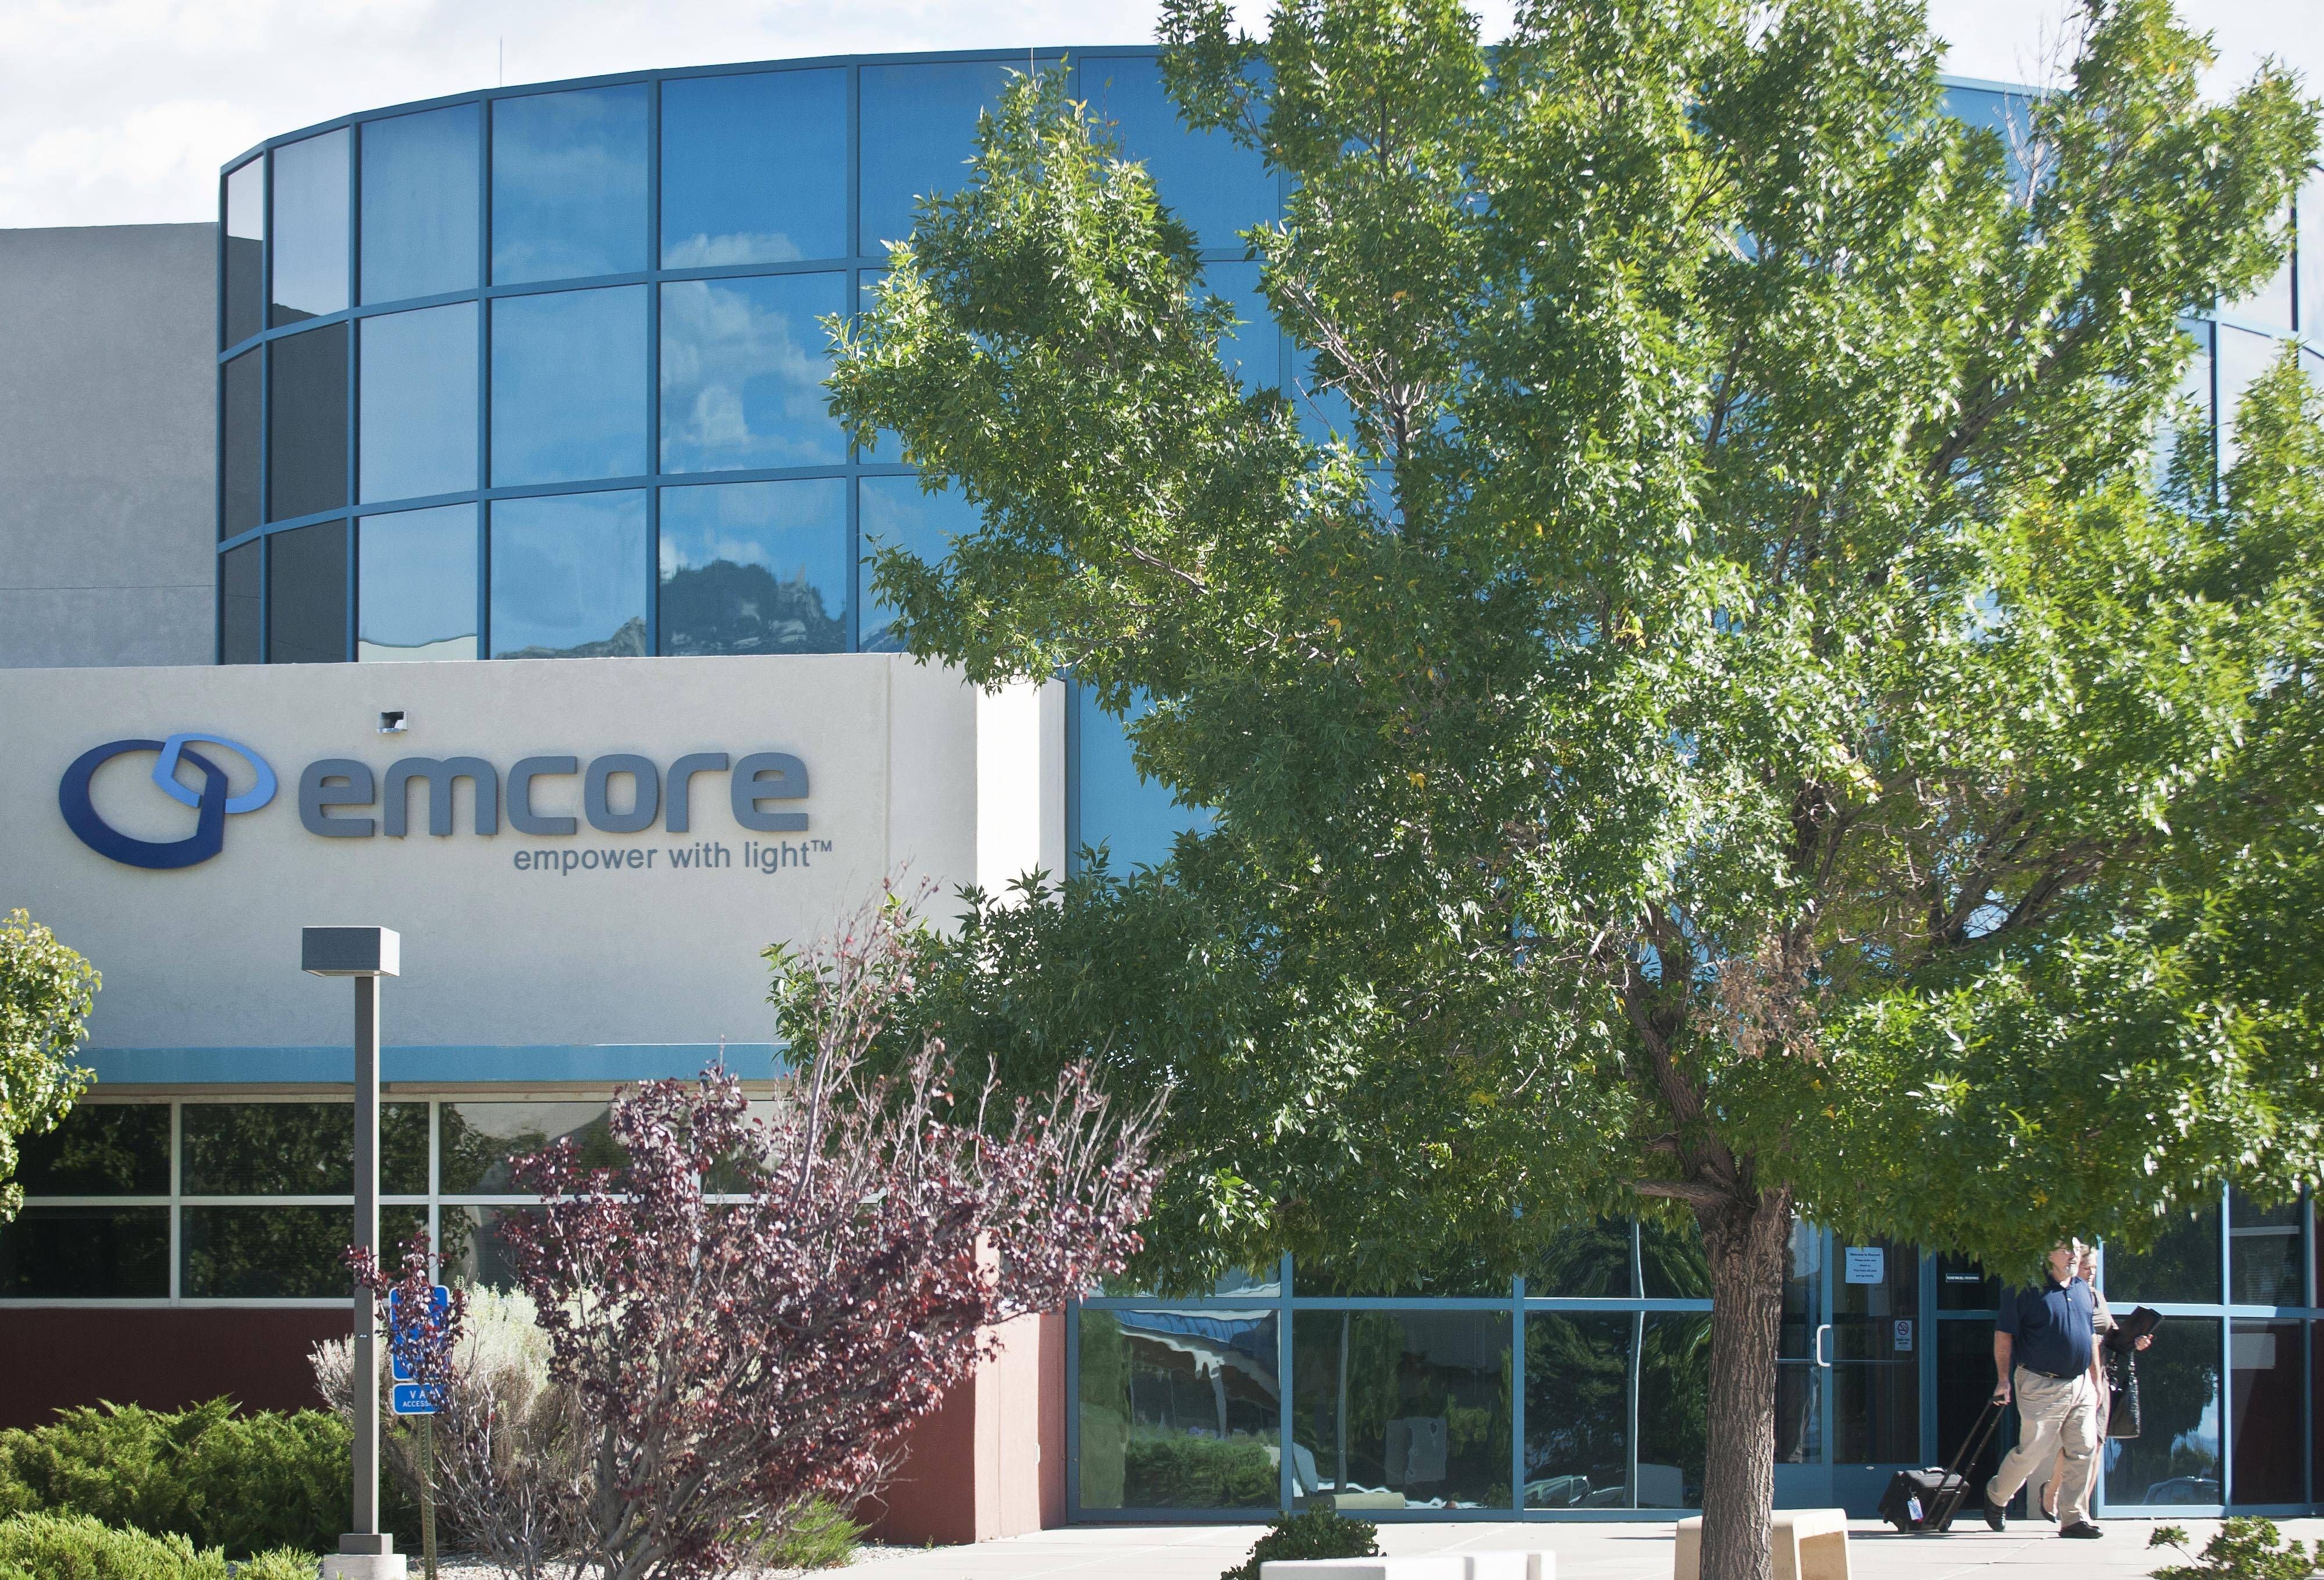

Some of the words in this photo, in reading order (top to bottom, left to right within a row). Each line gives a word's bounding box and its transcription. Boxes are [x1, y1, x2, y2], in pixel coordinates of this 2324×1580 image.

[298, 752, 809, 837] emcore
[514, 848, 658, 875] empower
[668, 842, 731, 868] with
